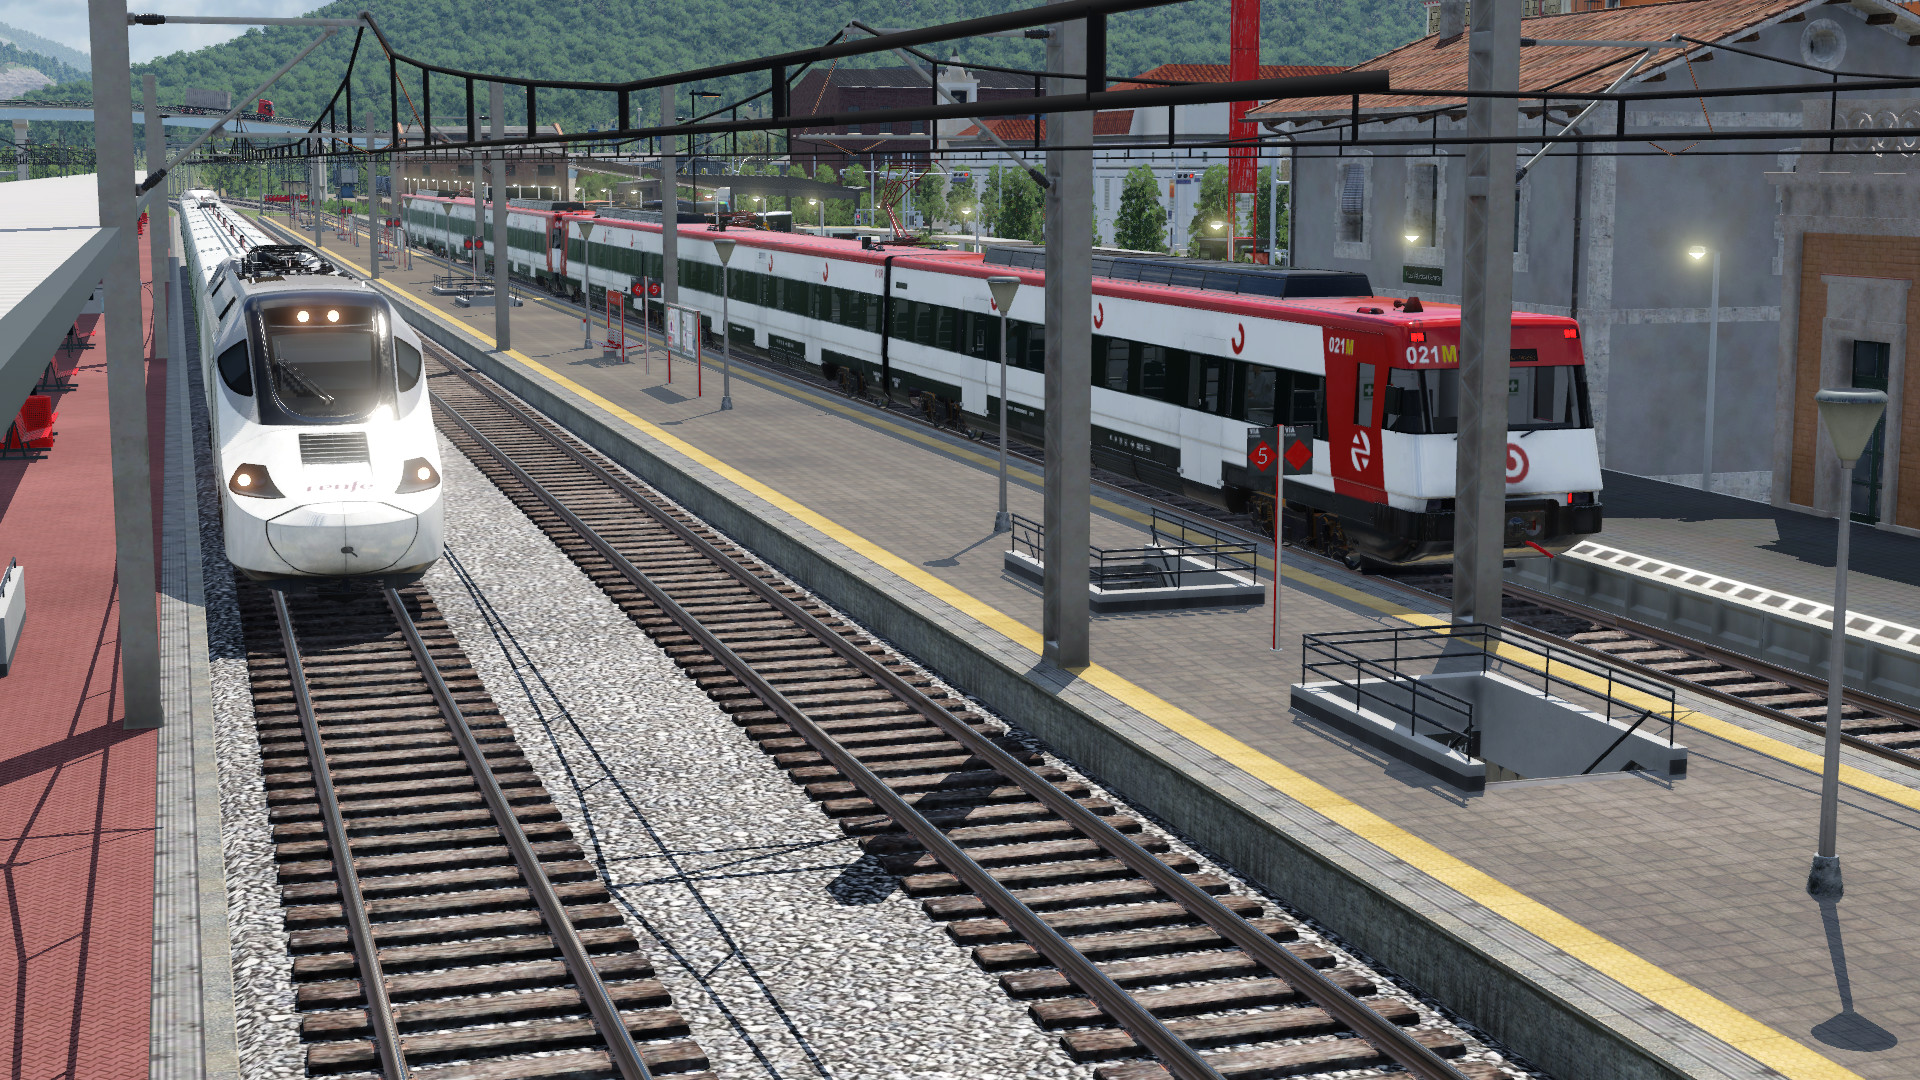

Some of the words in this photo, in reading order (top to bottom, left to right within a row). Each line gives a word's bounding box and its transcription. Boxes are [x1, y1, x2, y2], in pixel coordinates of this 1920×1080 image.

[652, 284, 658, 294] 5
[1328, 336, 1354, 356] 021M
[1405, 344, 1458, 365] 021M
[1257, 447, 1268, 465] 5
